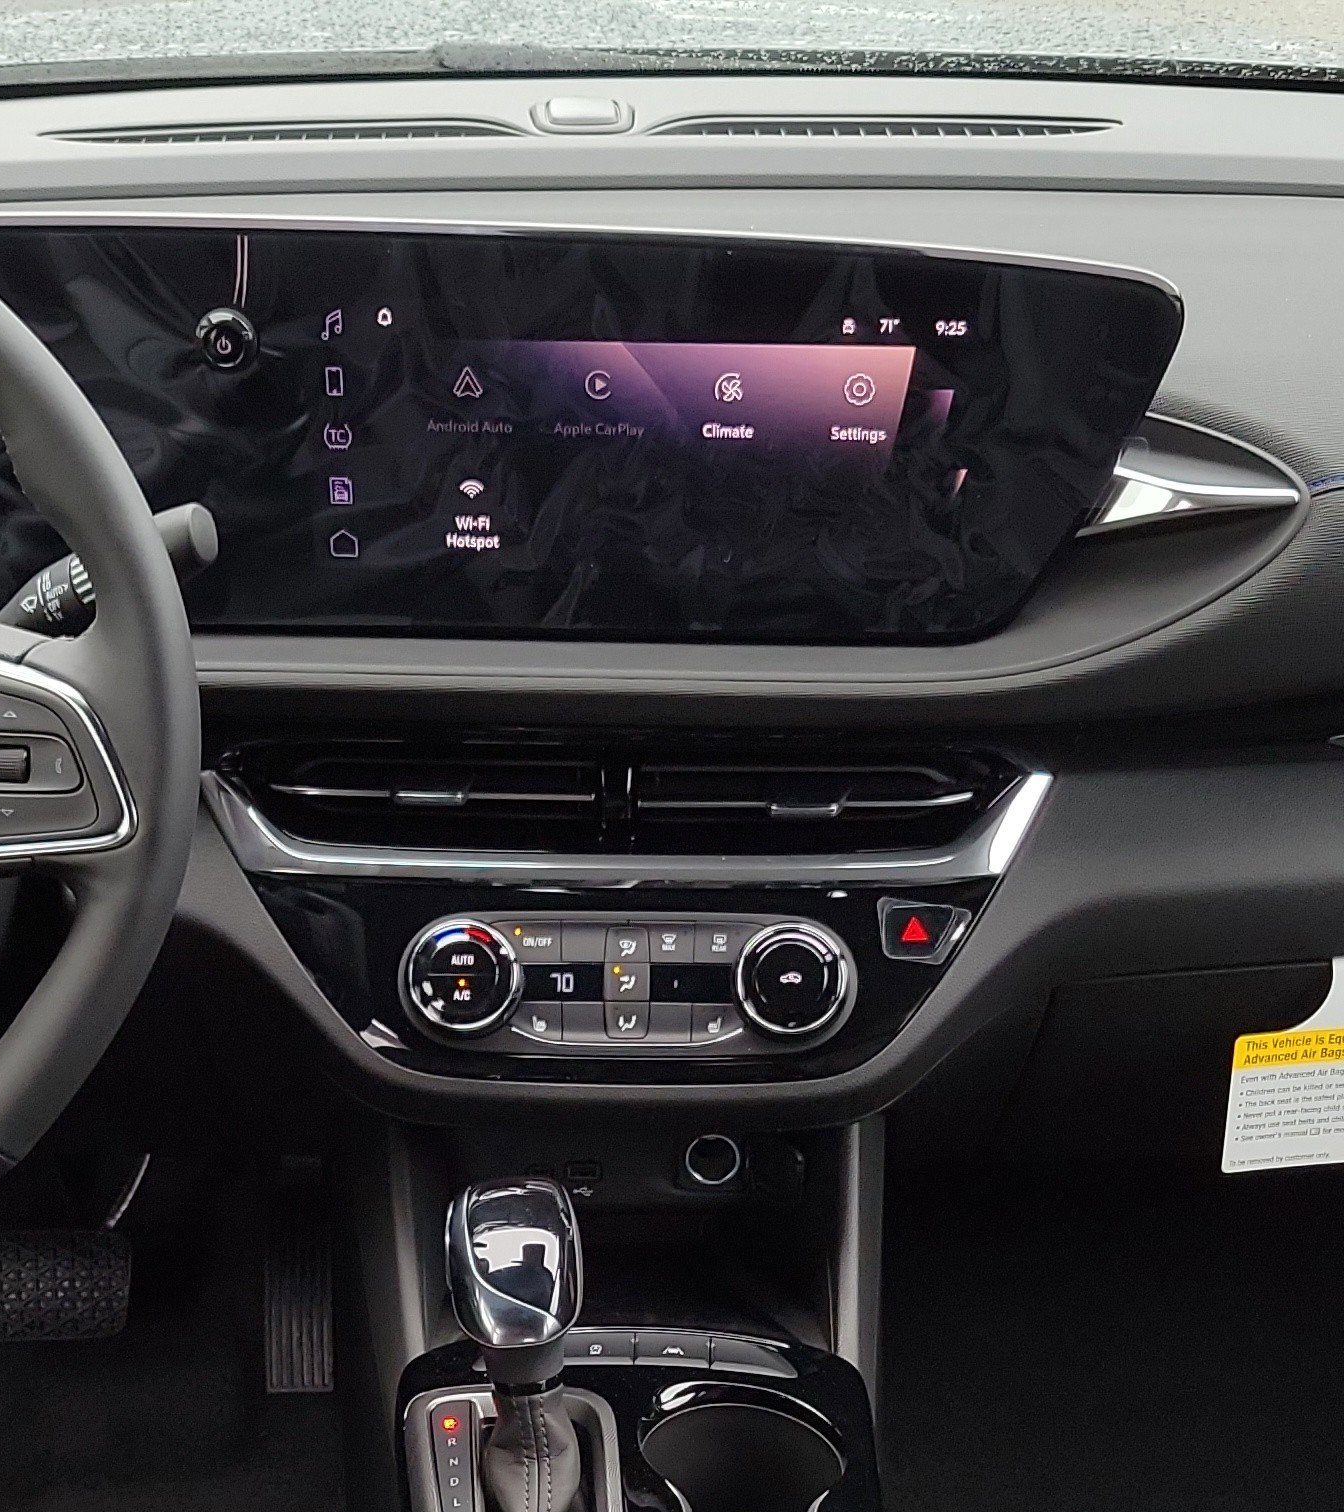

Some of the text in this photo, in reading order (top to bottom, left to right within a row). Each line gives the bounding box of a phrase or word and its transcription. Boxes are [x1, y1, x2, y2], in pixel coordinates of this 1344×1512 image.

[935, 320, 968, 337] 9:25
[427, 419, 513, 434] Android Auto
[554, 422, 645, 439] Apple CarPlay
[702, 422, 755, 439] Climate
[328, 429, 347, 443] TC
[830, 426, 887, 443] Settings
[445, 532, 501, 551] Hotspot
[522, 937, 552, 947] ON/OFF
[451, 954, 475, 966] AUTO
[549, 972, 574, 993] 70
[453, 989, 471, 1001] A/C
[1245, 1040, 1268, 1052] This
[1272, 1036, 1312, 1049] Vehicle
[1243, 1051, 1297, 1065] Advanced
[1301, 1048, 1317, 1059] Air
[1260, 1073, 1277, 1081] with
[1278, 1069, 1316, 1080] Advanced
[1316, 1068, 1328, 1076] Air
[447, 1437, 457, 1447] R
[449, 1457, 459, 1467] N
[450, 1477, 459, 1487] D
[453, 1498, 461, 1507] L
